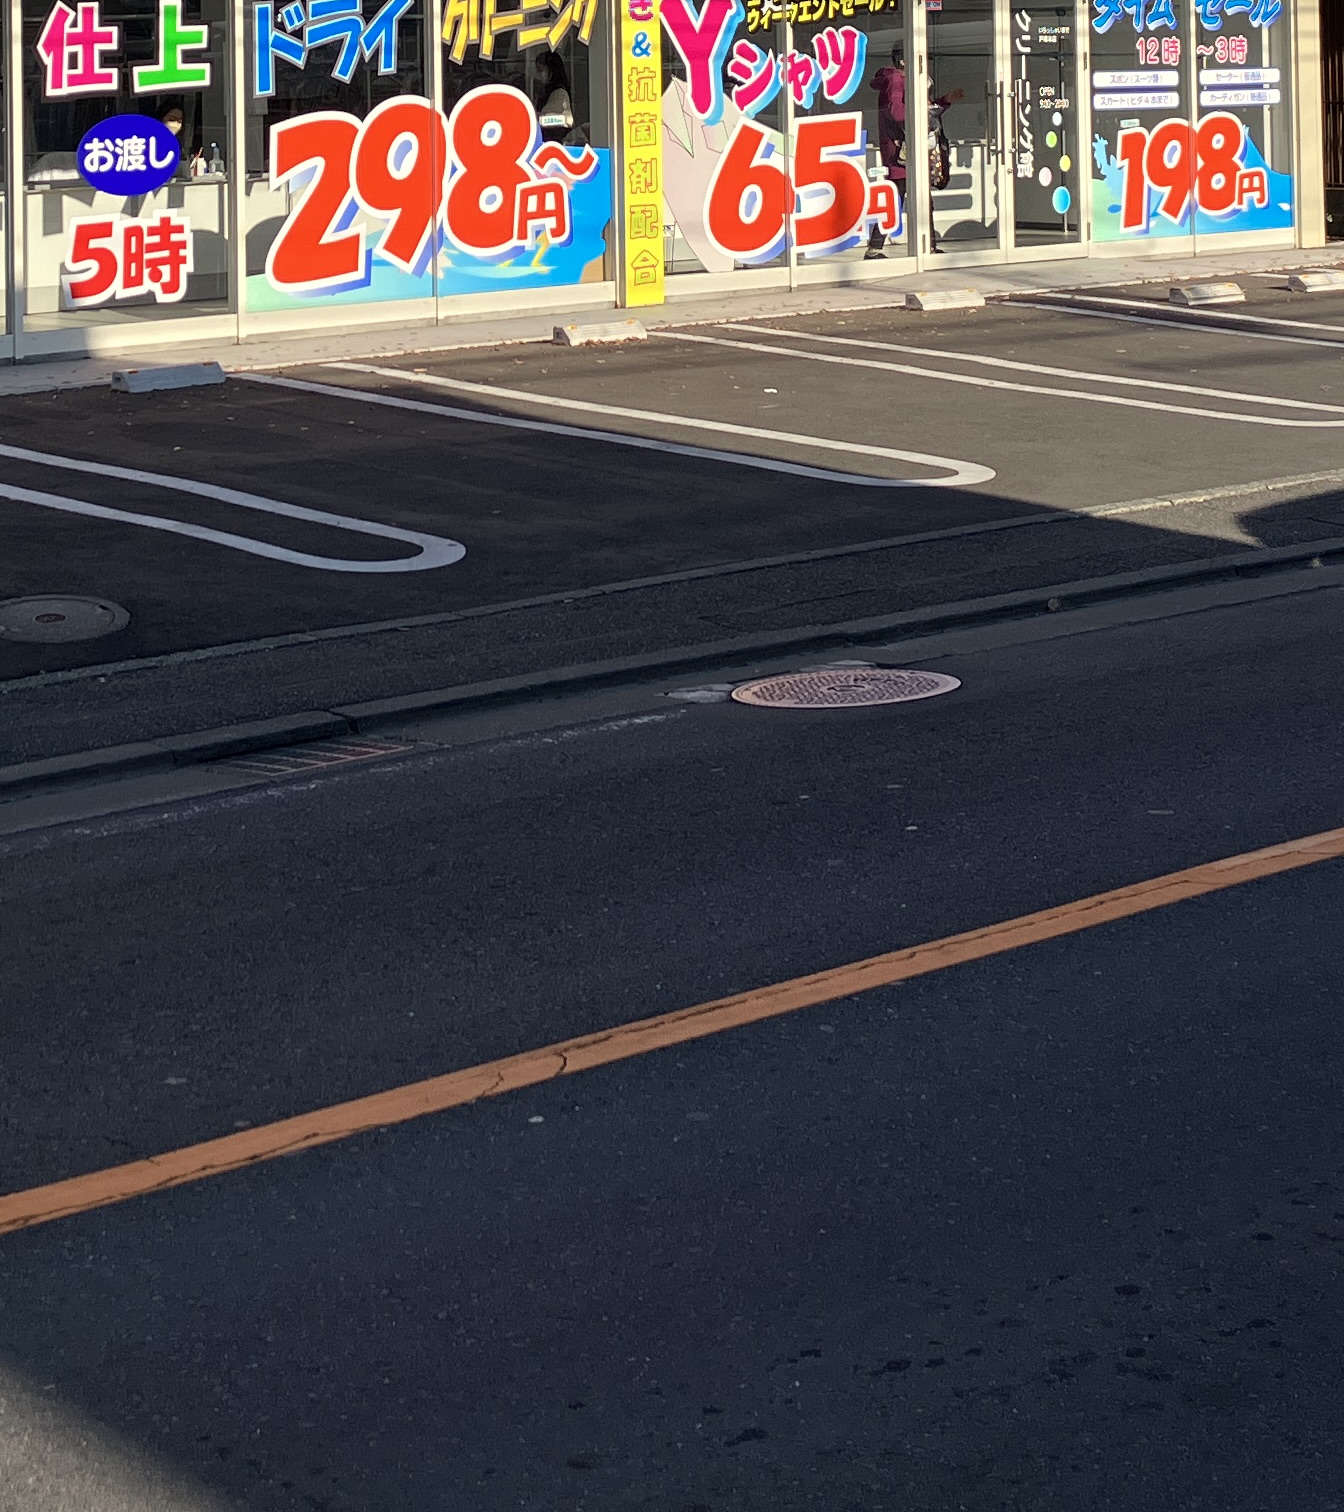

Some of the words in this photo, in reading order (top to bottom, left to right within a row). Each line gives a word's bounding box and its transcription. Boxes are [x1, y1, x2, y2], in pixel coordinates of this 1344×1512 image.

[37, 0, 211, 97] 仕上
[1136, 36, 1182, 65] 12時
[83, 135, 175, 173] お渡し
[703, 111, 903, 264] 65円
[1117, 111, 1270, 235] 198円
[61, 209, 195, 308] 5時
